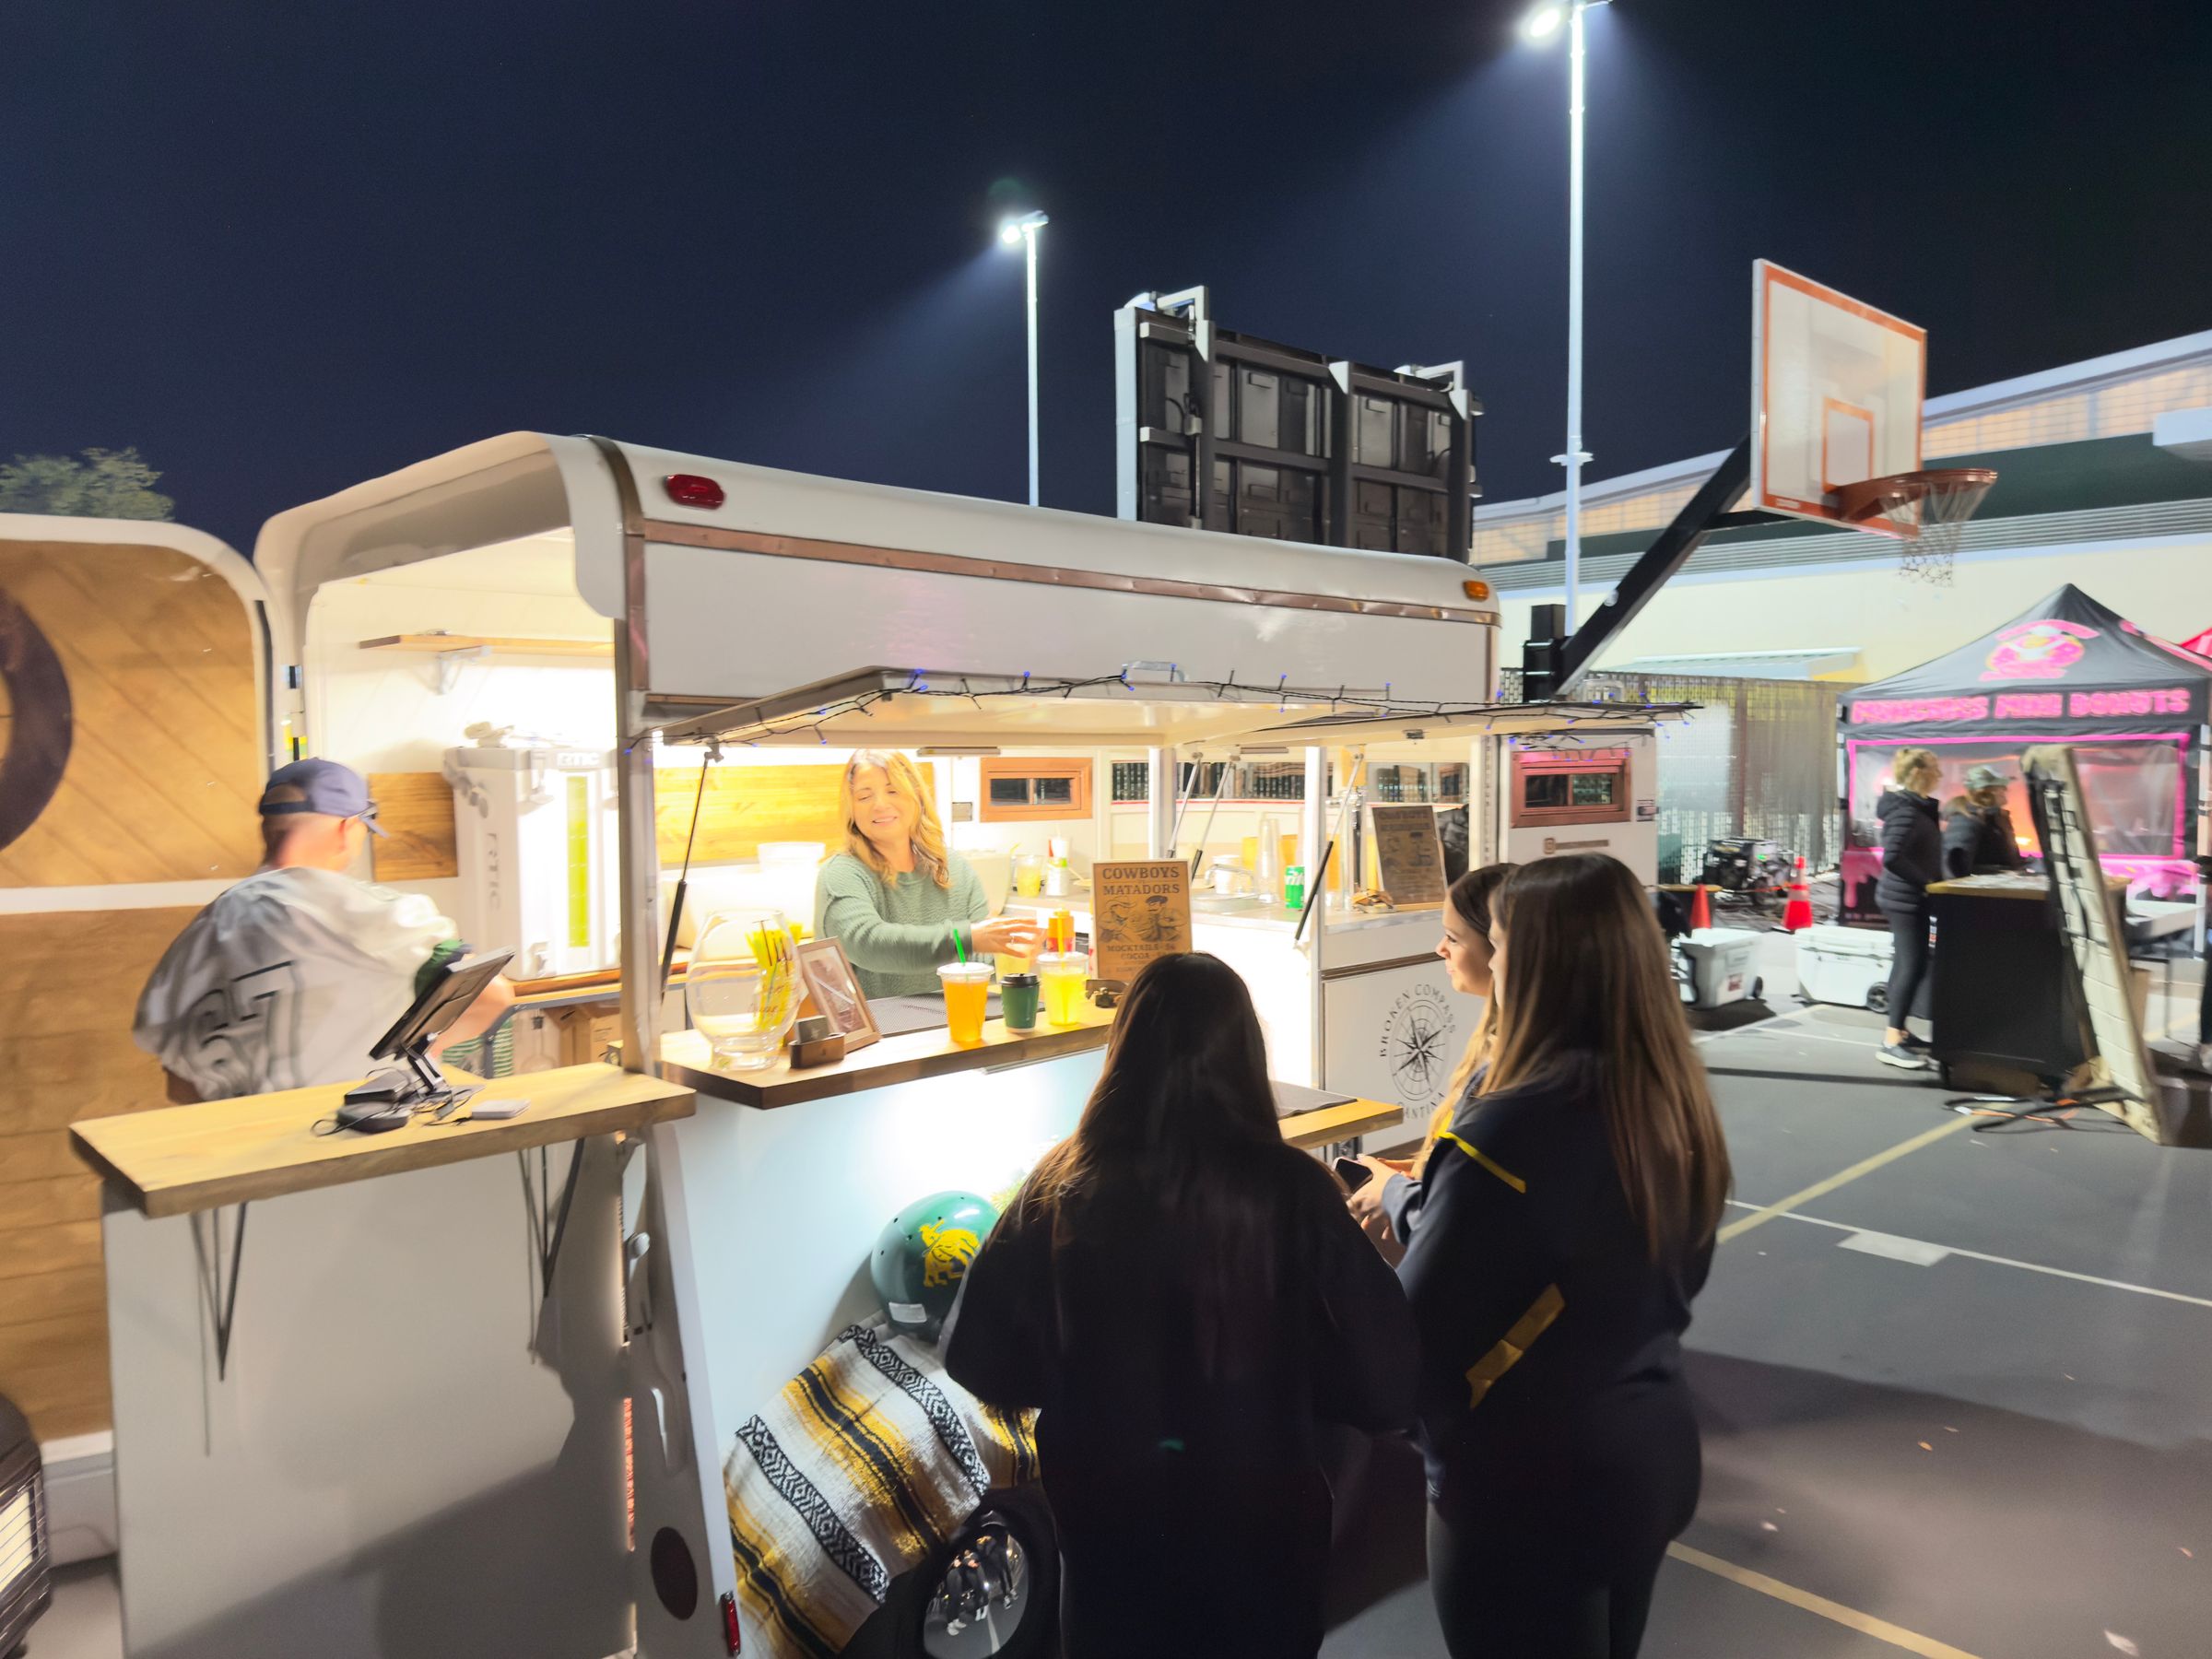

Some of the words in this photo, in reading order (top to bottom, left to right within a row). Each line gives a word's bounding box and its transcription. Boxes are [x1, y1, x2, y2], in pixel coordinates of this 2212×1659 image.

[2067, 688, 2192, 719] DONUTS
[487, 832, 500, 911] RTIC
[1102, 866, 1181, 880] COWBOYS
[1103, 883, 1181, 896] MATADORS
[1106, 943, 1159, 952] MOCKTAILS
[1121, 952, 1151, 960] COCOA
[1380, 990, 1410, 1057] BROKEN
[1415, 983, 1456, 1033] COMPASS
